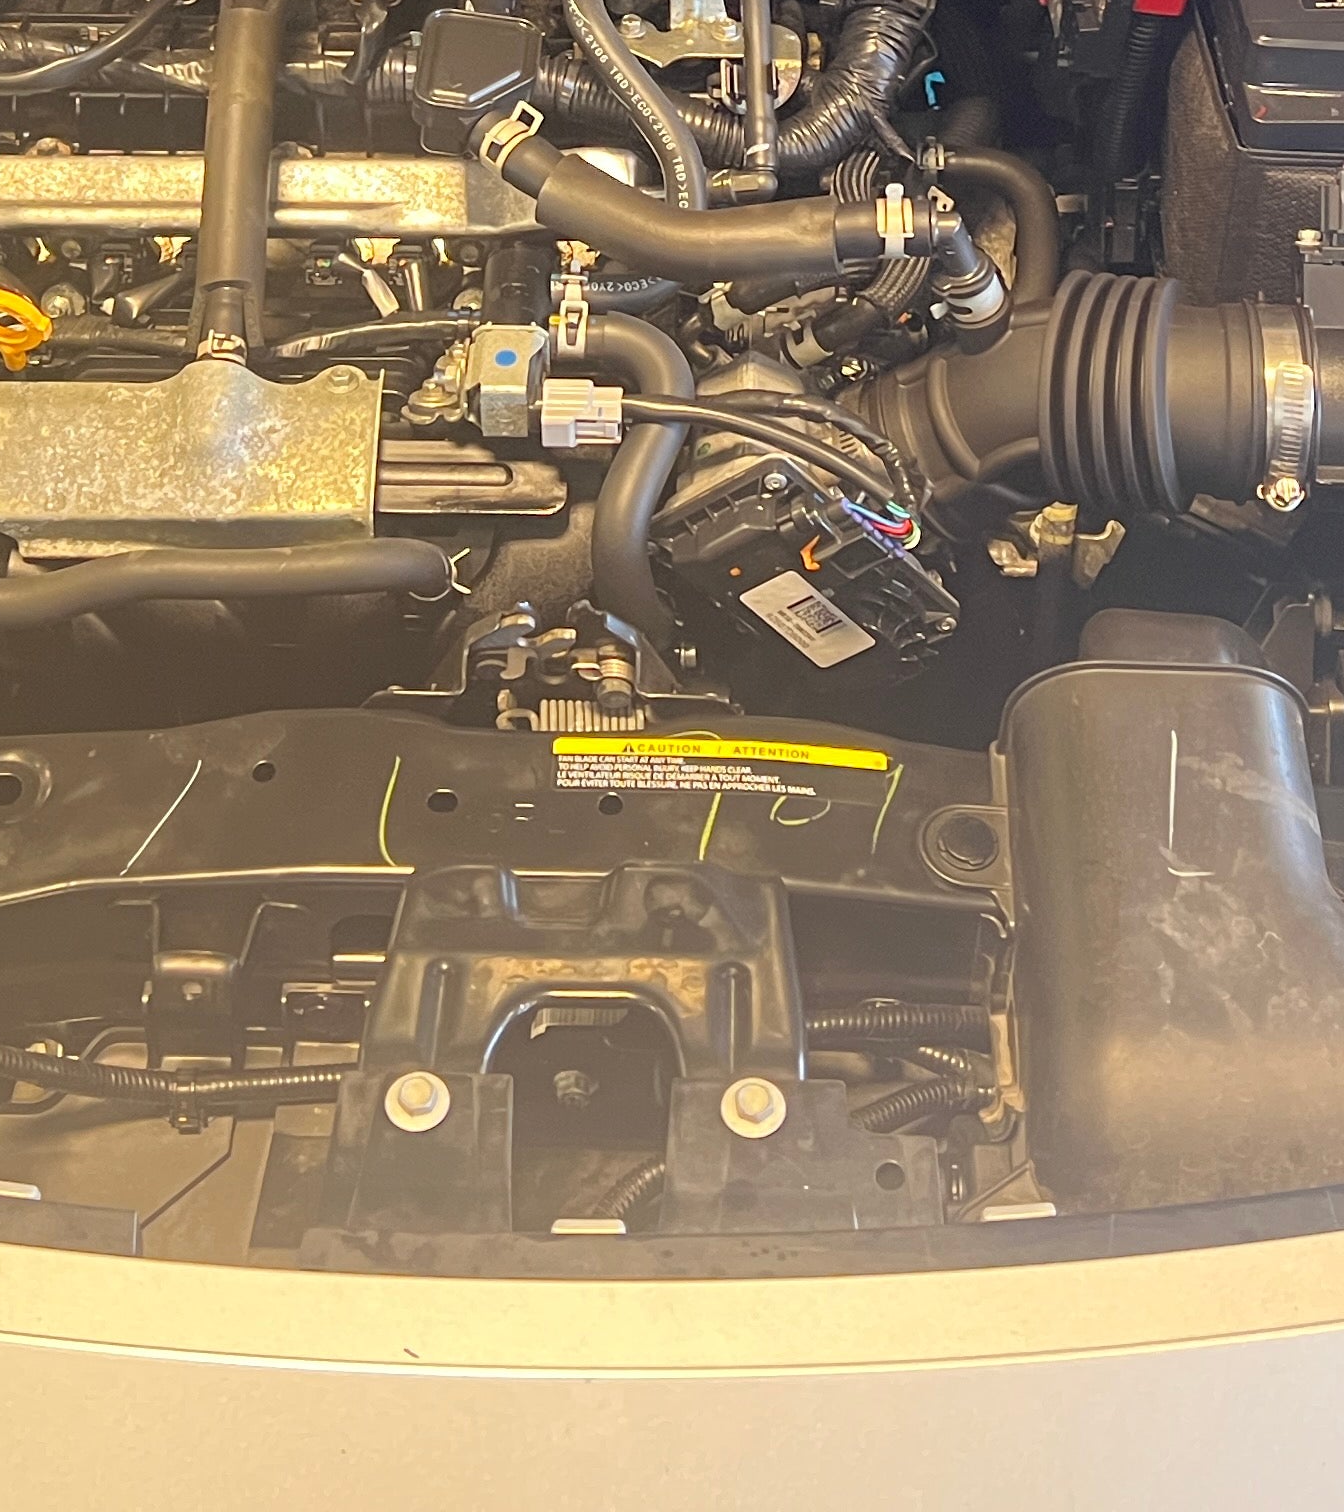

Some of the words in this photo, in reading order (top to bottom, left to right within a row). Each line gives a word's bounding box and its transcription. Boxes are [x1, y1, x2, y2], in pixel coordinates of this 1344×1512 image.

[637, 743, 701, 754] CAUTION
[733, 745, 810, 760] ATTENTION
[558, 754, 574, 763] FAN
[575, 754, 598, 763] BLADE
[598, 755, 616, 763] CAN
[616, 755, 638, 764] START
[639, 756, 649, 764] AT
[650, 756, 666, 765] ANY
[558, 762, 570, 771] TO
[570, 762, 589, 771] HELP
[589, 763, 614, 772] AVOID
[613, 763, 652, 772] PERSONAL
[680, 764, 699, 773] KEEP
[699, 765, 727, 774] HANDS
[556, 770, 568, 779] LE
[567, 770, 622, 780] VENTILATEUR
[621, 771, 652, 781] RISQUE
[652, 772, 665, 781] DE
[719, 773, 741, 783] TOUT
[556, 778, 581, 787] POUR
[609, 779, 636, 788] TOUTE
[679, 780, 691, 789] NE
[692, 781, 708, 790] PAS
[708, 781, 721, 790] EN
[720, 782, 771, 792] APPROCHER
[771, 784, 787, 794] LES
